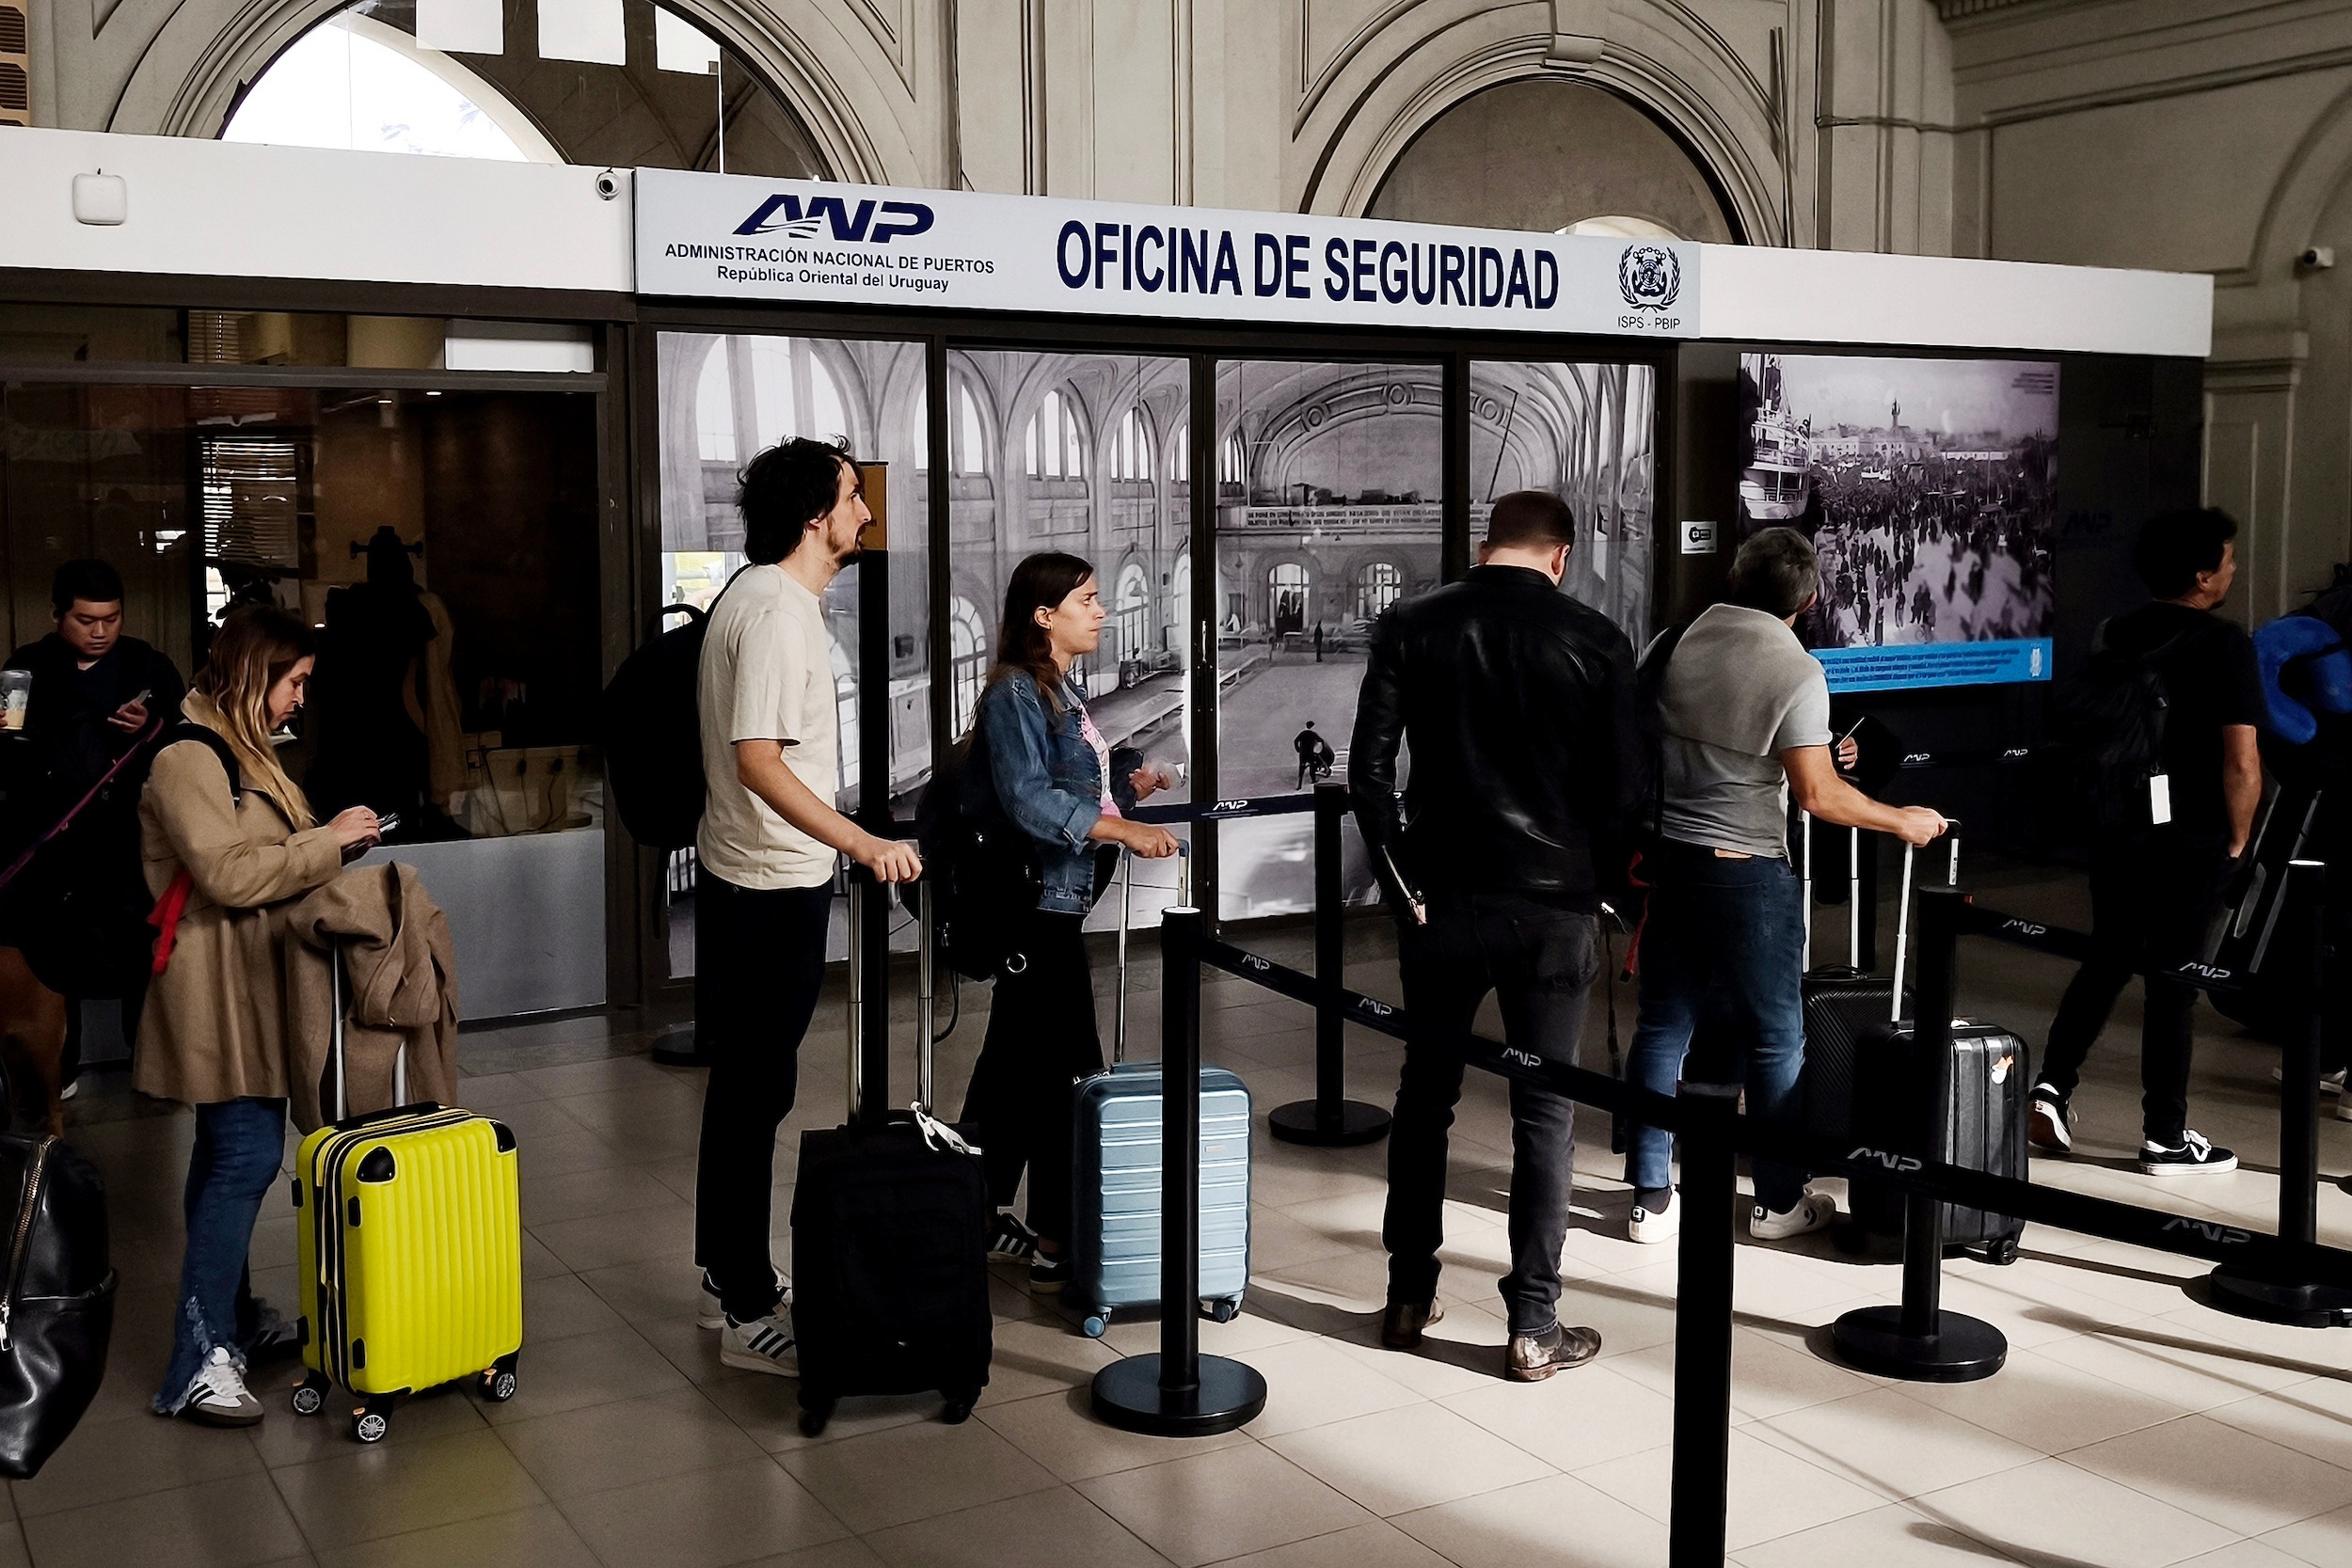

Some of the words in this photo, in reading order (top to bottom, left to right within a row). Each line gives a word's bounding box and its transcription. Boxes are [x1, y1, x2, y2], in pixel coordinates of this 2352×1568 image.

[731, 194, 934, 243] ANP
[664, 243, 808, 264] ADMINISTRACIÓN
[813, 250, 895, 269] NACIONAL
[898, 256, 919, 270] DE
[924, 257, 994, 275] PUERTOS
[1057, 219, 1243, 296] OFICINA
[1254, 232, 1311, 299] DE
[1324, 237, 1559, 309] SEGURIDAD
[717, 265, 794, 283] República
[799, 269, 858, 286] Oriental
[862, 273, 883, 287] del
[889, 274, 949, 293] Uruguay
[1617, 315, 1645, 329] ISPS
[1654, 317, 1681, 330] PBIP
